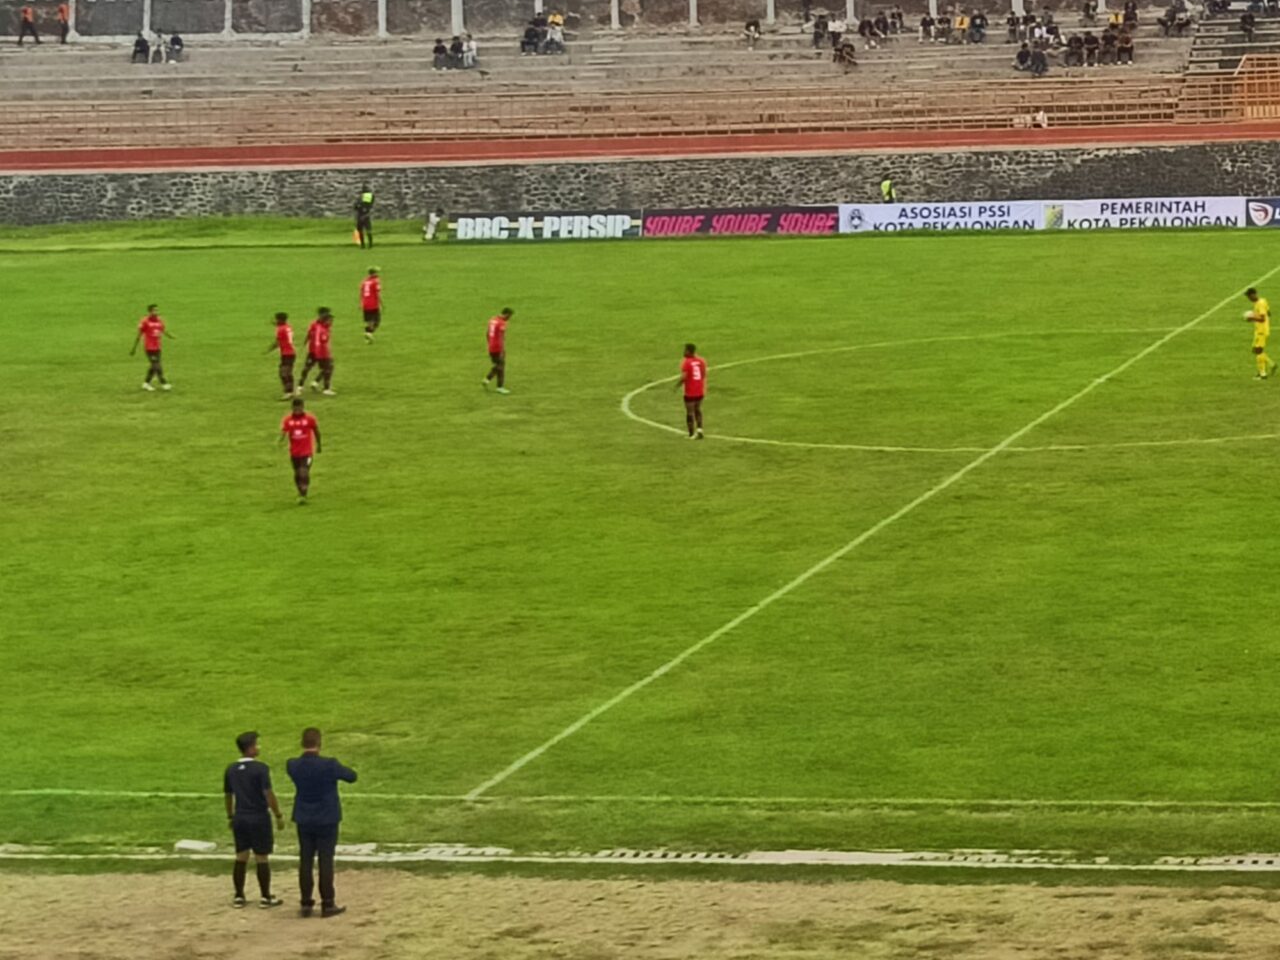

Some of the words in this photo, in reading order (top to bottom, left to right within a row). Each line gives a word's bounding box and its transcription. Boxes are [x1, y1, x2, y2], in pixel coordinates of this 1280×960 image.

[898, 206, 972, 219] ASOSIASI
[978, 205, 1010, 219] PSSI
[1099, 201, 1206, 215] PEMERINTAH
[517, 216, 535, 240] X
[543, 214, 632, 239] PERSIP
[1067, 217, 1111, 229] KOTA
